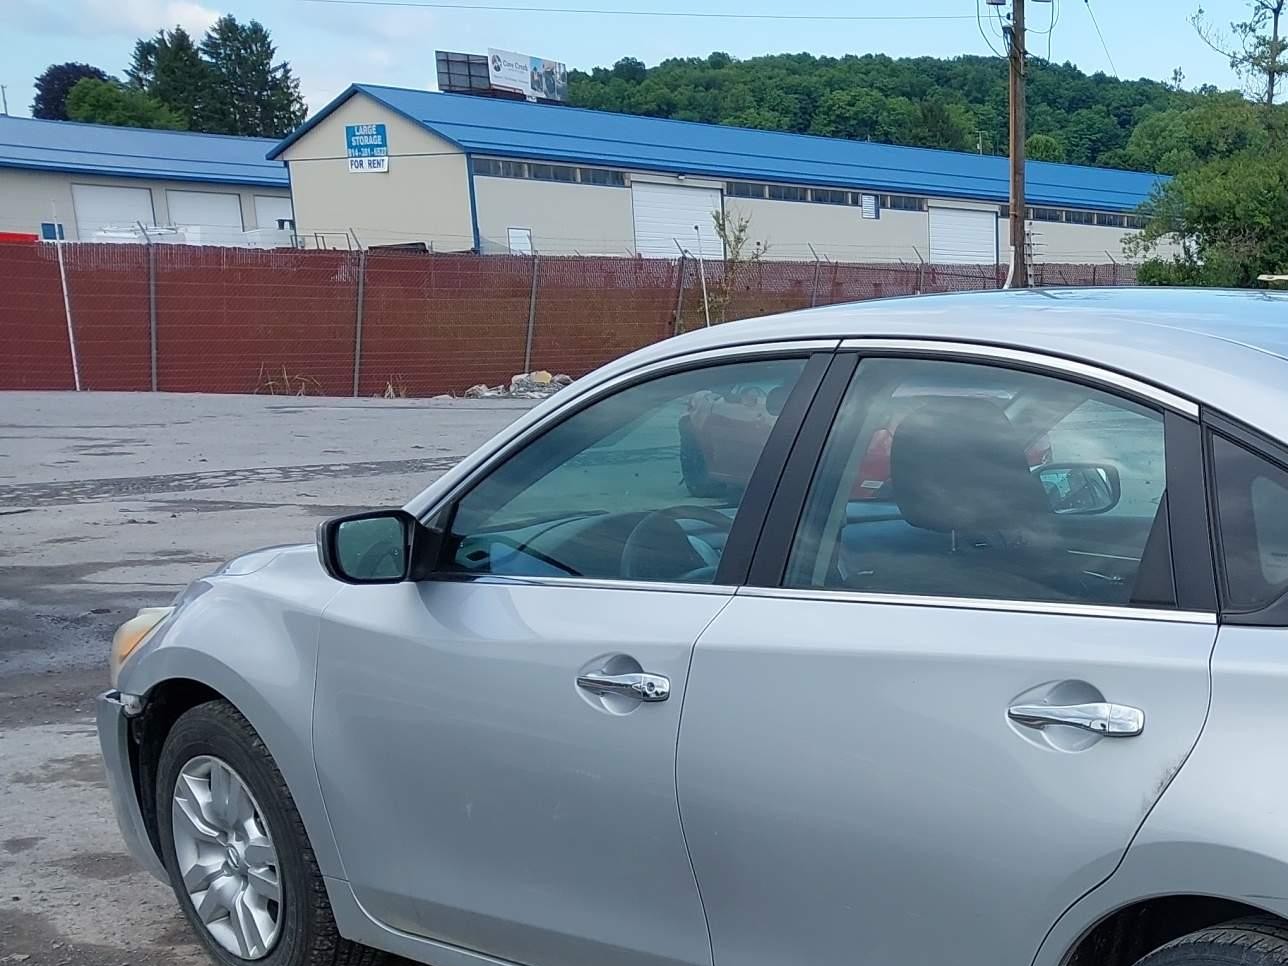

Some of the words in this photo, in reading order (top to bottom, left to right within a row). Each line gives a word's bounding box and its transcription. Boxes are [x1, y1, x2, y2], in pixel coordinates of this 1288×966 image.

[354, 125, 377, 135] LARGE
[351, 135, 383, 146] STORAGE
[350, 159, 364, 169] FOR
[367, 159, 385, 168] RENT
